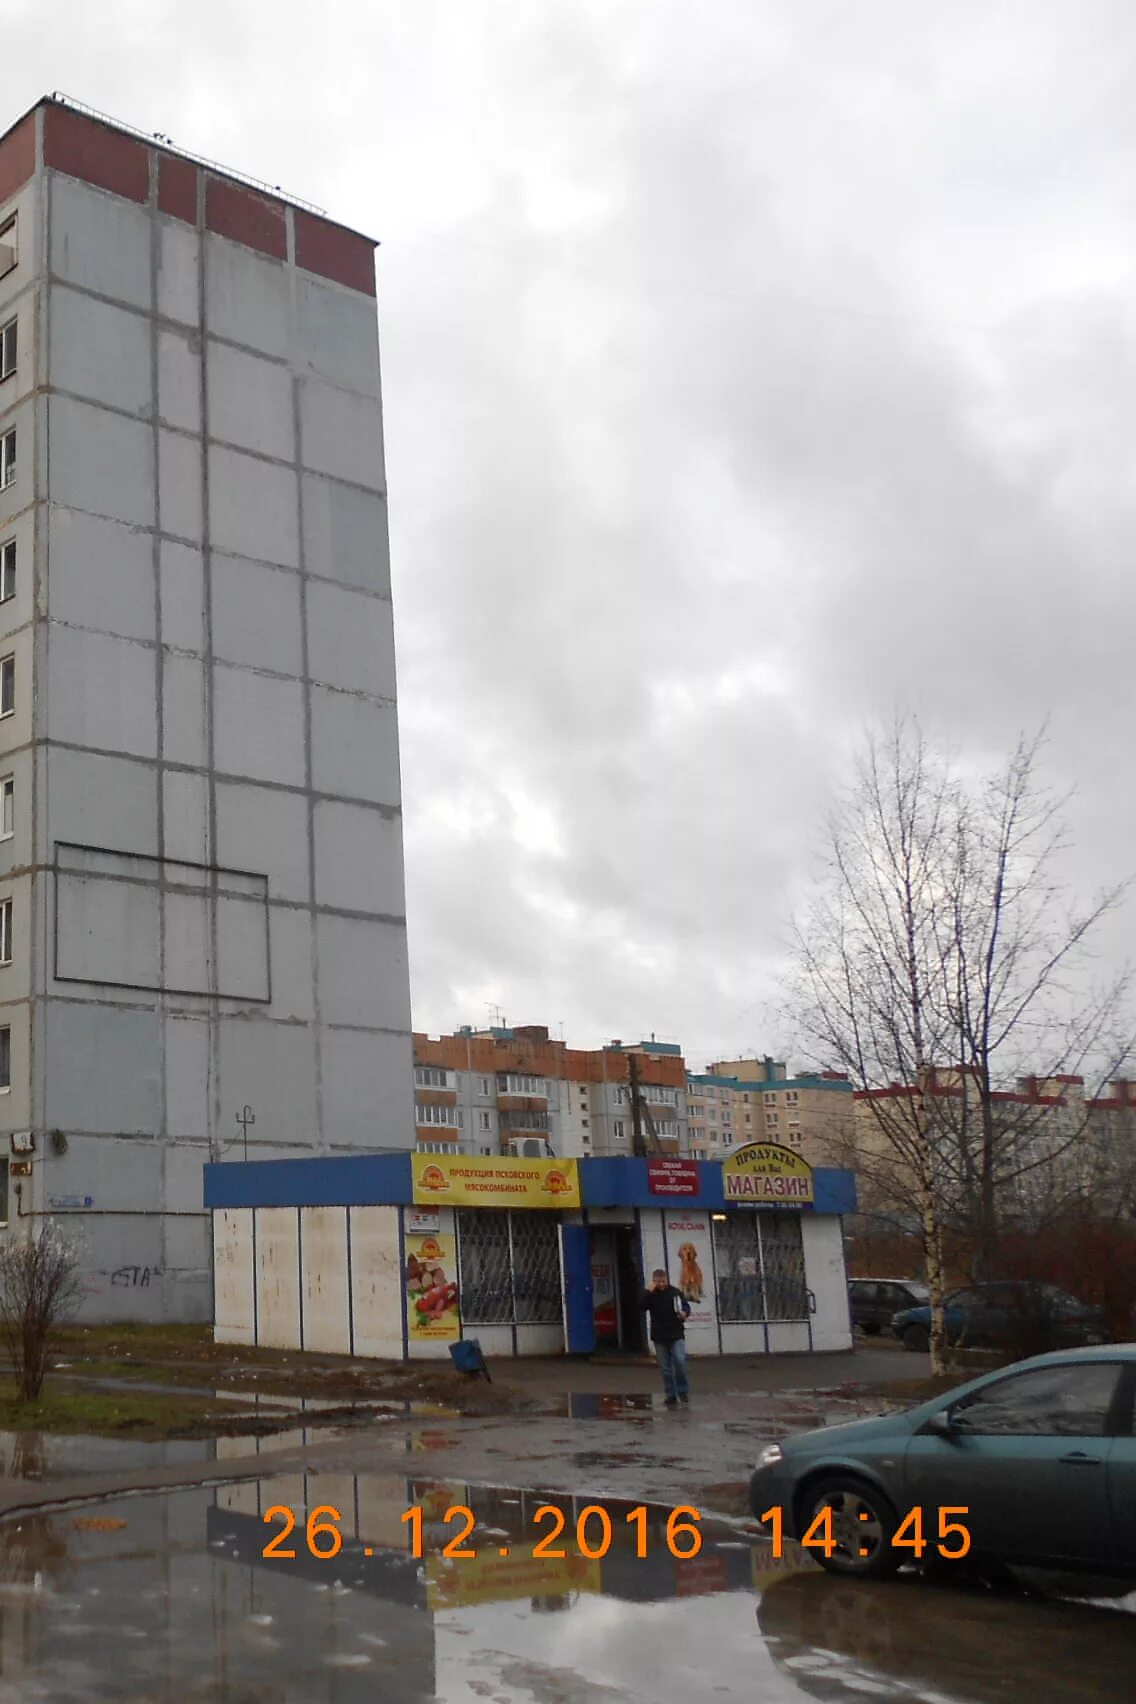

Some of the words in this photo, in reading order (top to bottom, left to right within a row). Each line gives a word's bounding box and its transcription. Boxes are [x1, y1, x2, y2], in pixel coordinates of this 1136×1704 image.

[736, 1148, 795, 1168] ПРОДУКТЫ
[449, 1168, 494, 1179] ПРОДУКЦИЯ
[495, 1170, 540, 1180] ПСКОВСКОГО
[464, 1183, 528, 1193] МЯСОКОМБИНАТА
[727, 1175, 809, 1196] МАГАЗИН
